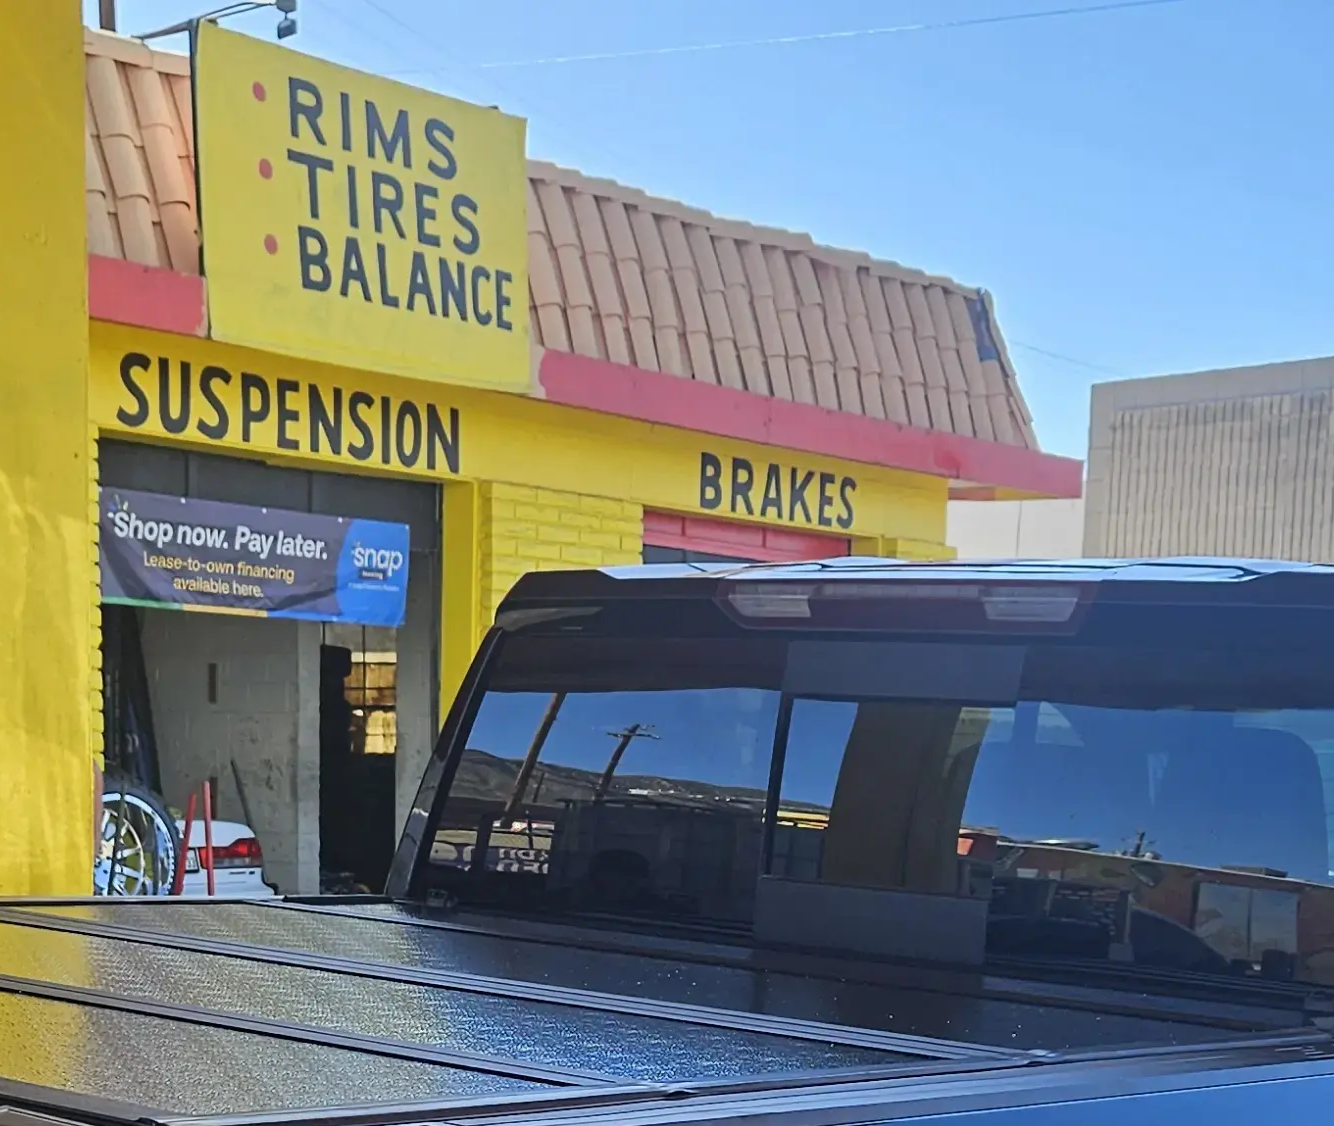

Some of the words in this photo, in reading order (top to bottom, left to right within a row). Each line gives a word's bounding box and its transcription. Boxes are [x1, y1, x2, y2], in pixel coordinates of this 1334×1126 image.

[288, 77, 458, 180] RIMS
[287, 148, 480, 256] TIRES
[297, 224, 513, 332] BALANCE
[116, 352, 460, 474] SUSPENSION
[699, 451, 857, 529] BRAKES
[114, 511, 173, 548] Shop
[176, 524, 229, 549] now.
[235, 526, 274, 560] Pay
[277, 530, 328, 560] later.
[143, 551, 234, 576] Lease-to-own
[237, 561, 295, 584] financing
[352, 546, 403, 577] snap
[173, 576, 230, 595] available
[233, 582, 264, 598] here.
